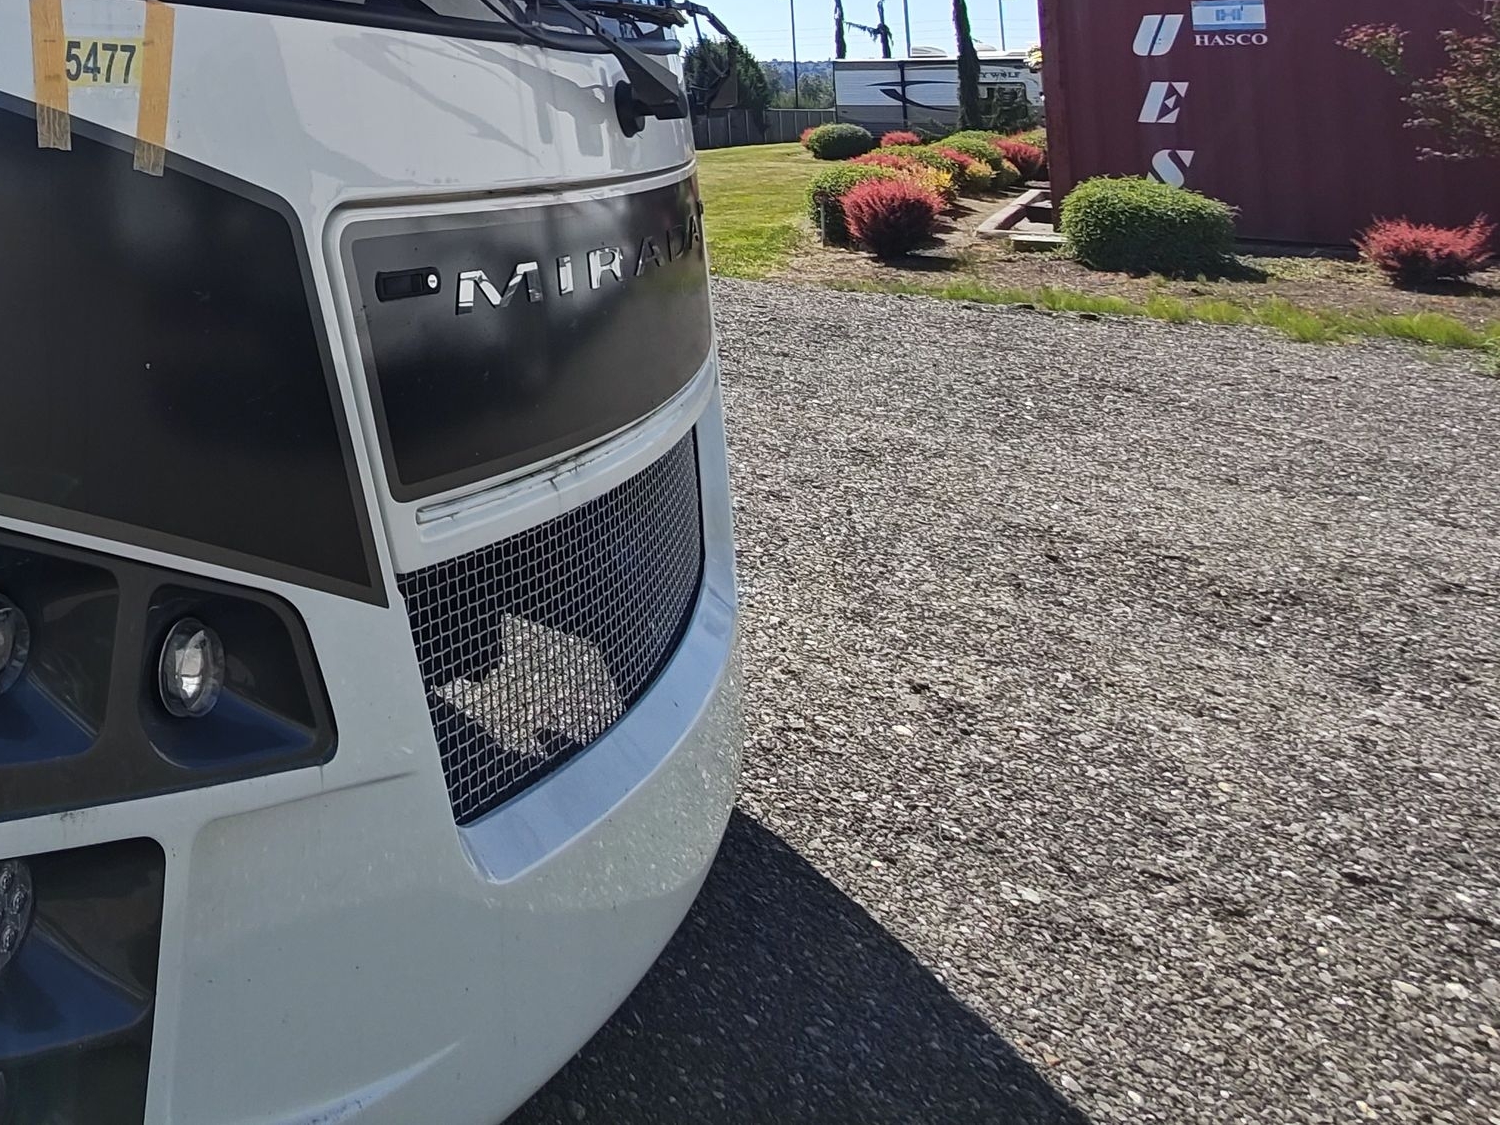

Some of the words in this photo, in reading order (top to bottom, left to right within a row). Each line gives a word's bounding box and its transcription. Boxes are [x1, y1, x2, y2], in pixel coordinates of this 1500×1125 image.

[1194, 33, 1268, 46] HASCO
[65, 40, 136, 84] 5477
[456, 213, 701, 313] MIRADA
